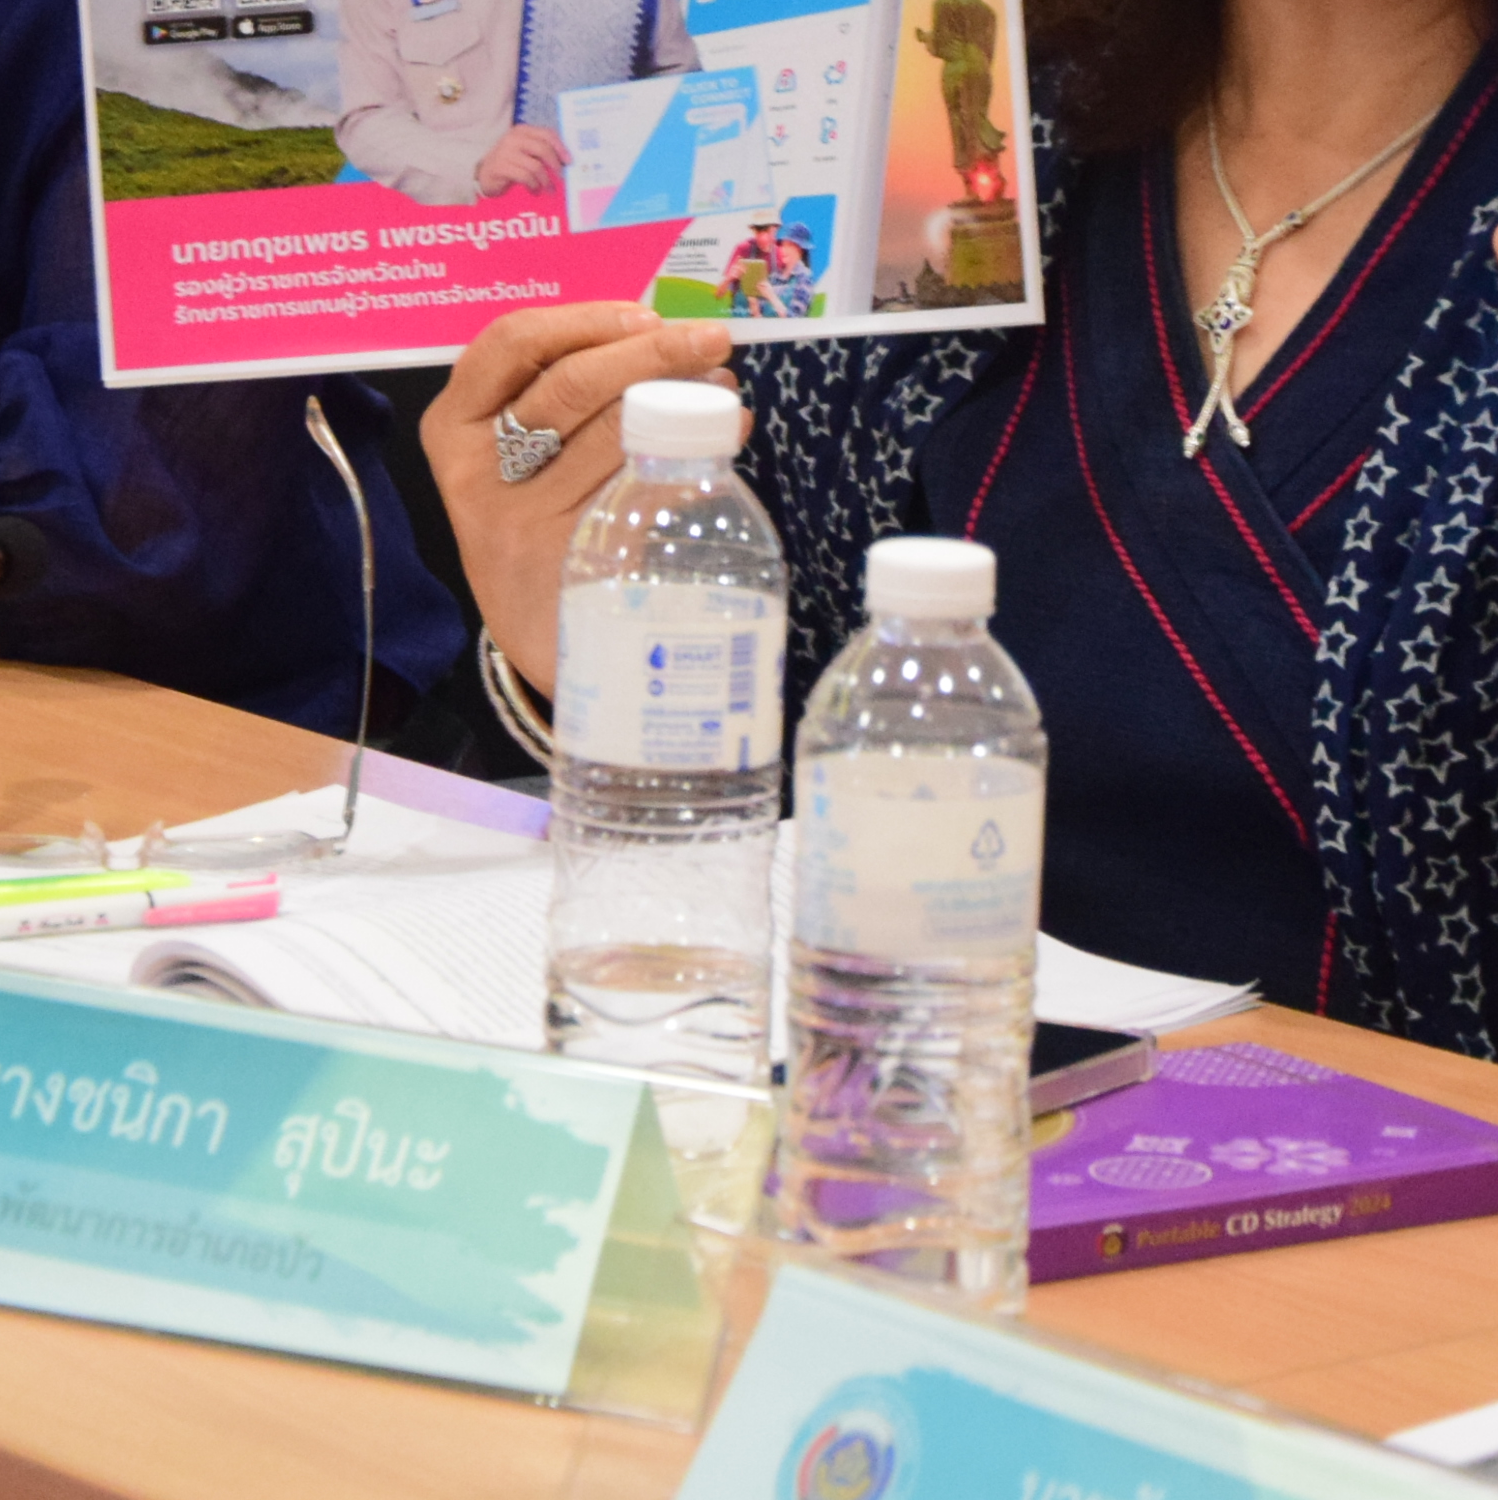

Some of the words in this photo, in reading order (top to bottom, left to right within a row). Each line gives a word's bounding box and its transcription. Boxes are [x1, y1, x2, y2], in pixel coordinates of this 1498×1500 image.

[174, 258, 446, 299] รองผู้ว่าราชการจังหวัดน่าน
[273, 1098, 452, 1199] สุปินะ
[1137, 1222, 1221, 1247] Portable
[1226, 1212, 1259, 1236] CD
[1264, 1203, 1343, 1228] Strategy
